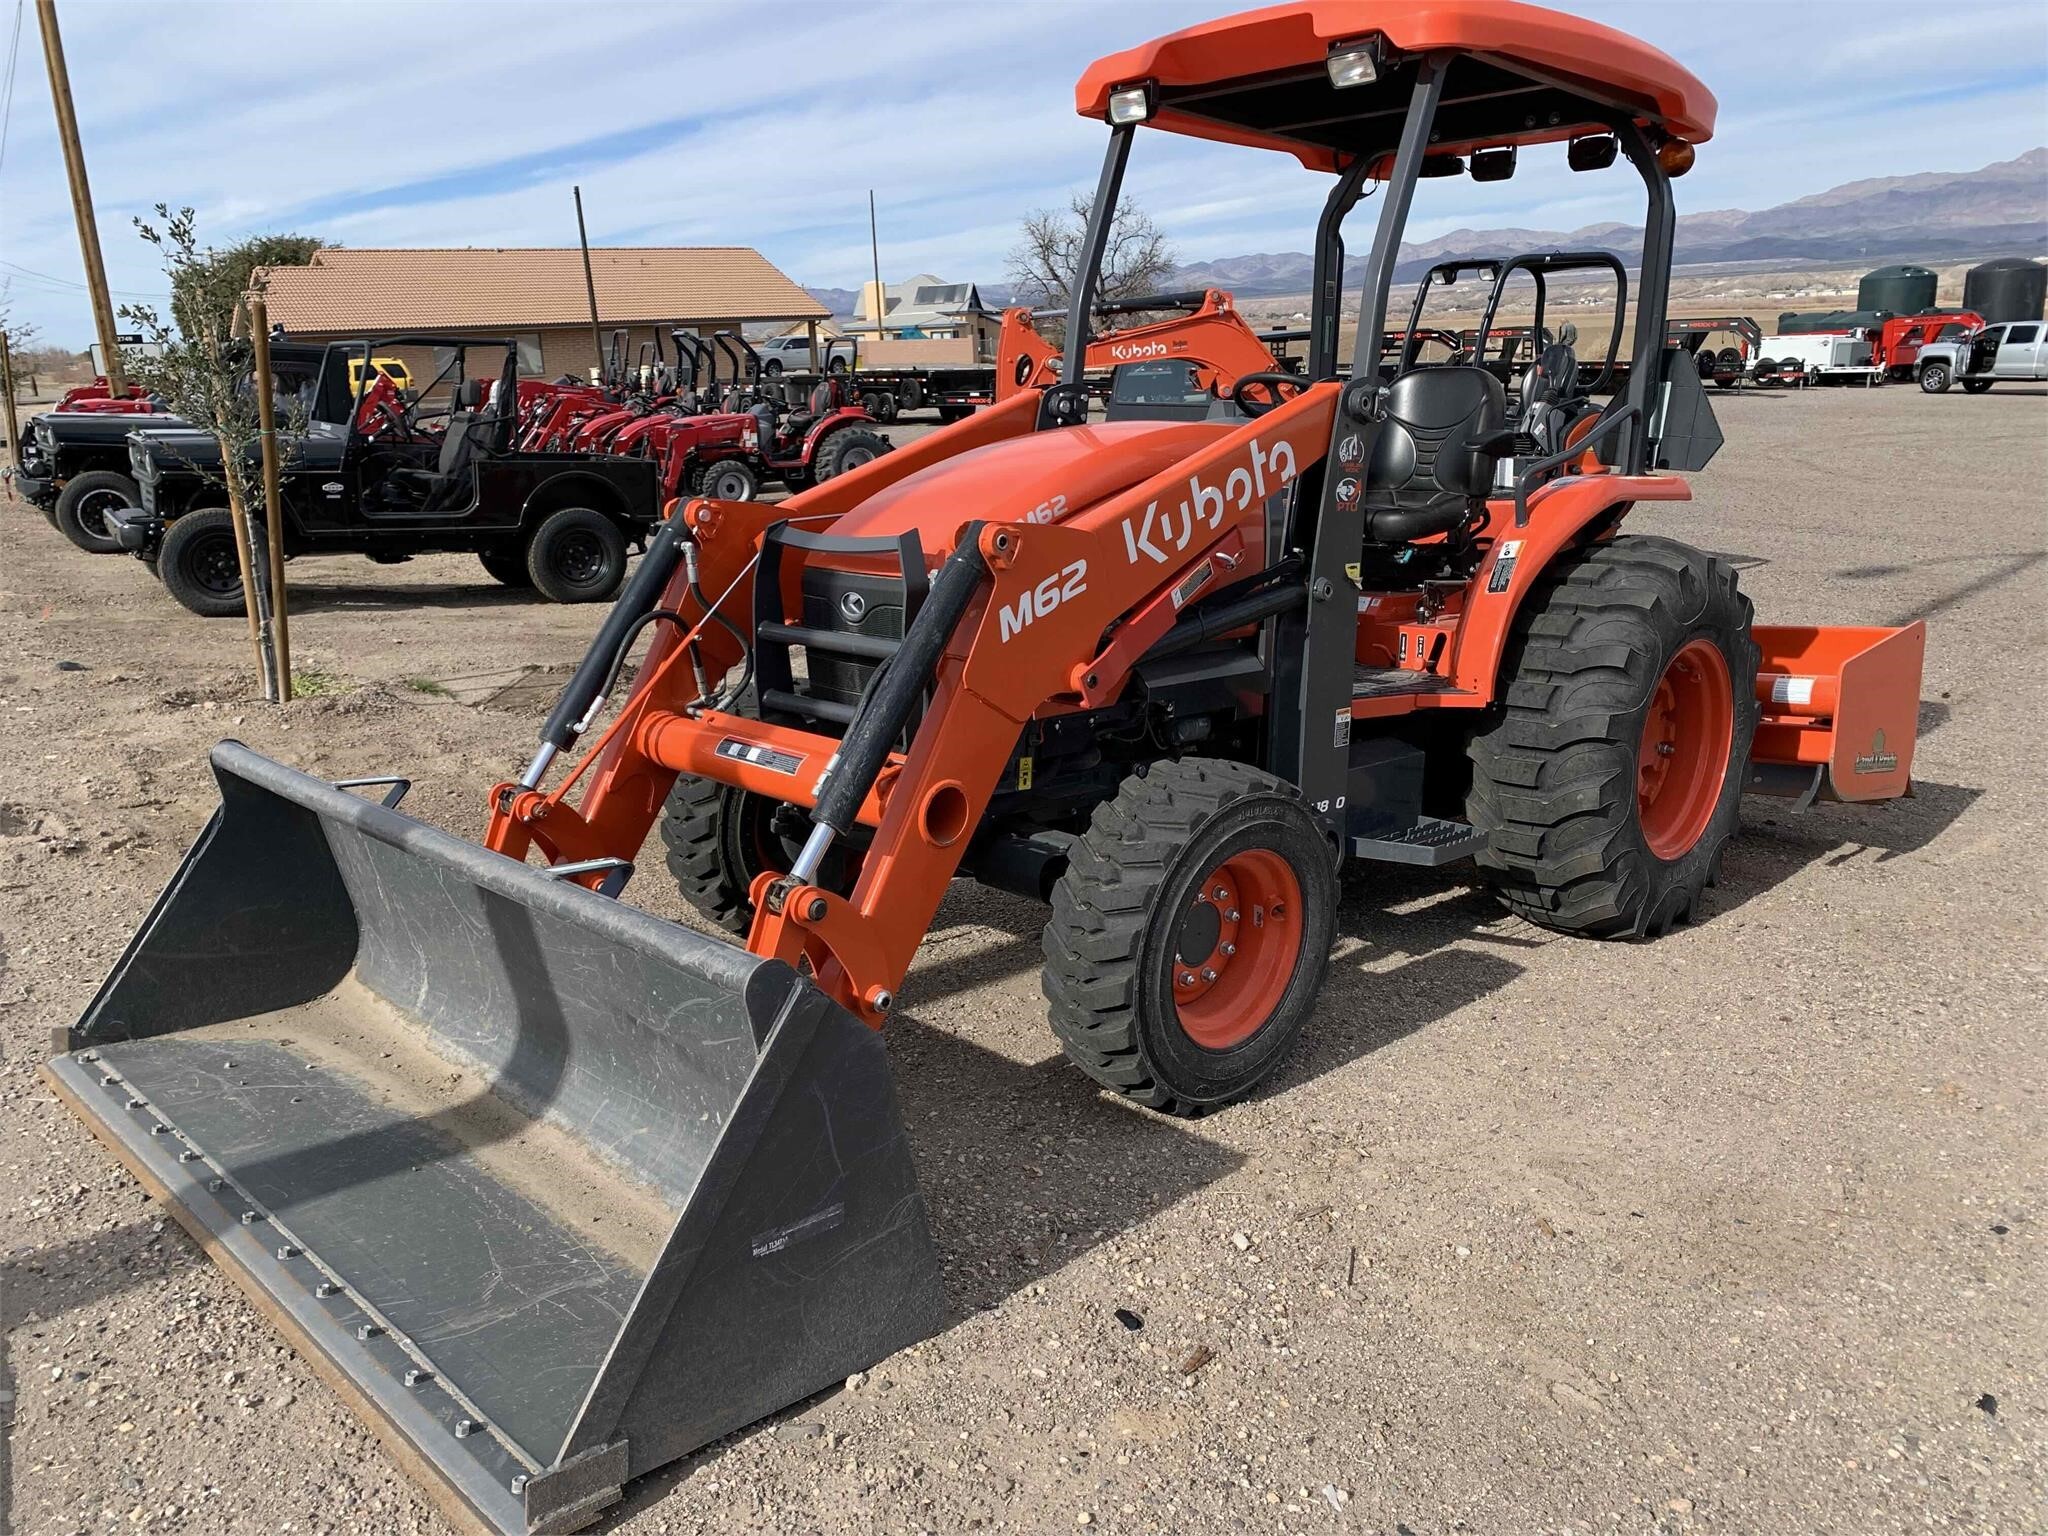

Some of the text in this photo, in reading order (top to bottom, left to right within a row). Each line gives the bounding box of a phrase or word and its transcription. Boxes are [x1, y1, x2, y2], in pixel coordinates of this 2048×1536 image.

[1111, 341, 1167, 359] Kubota
[1121, 438, 1297, 564] Kubota
[1336, 501, 1359, 512] PTO
[999, 558, 1088, 644] M62
